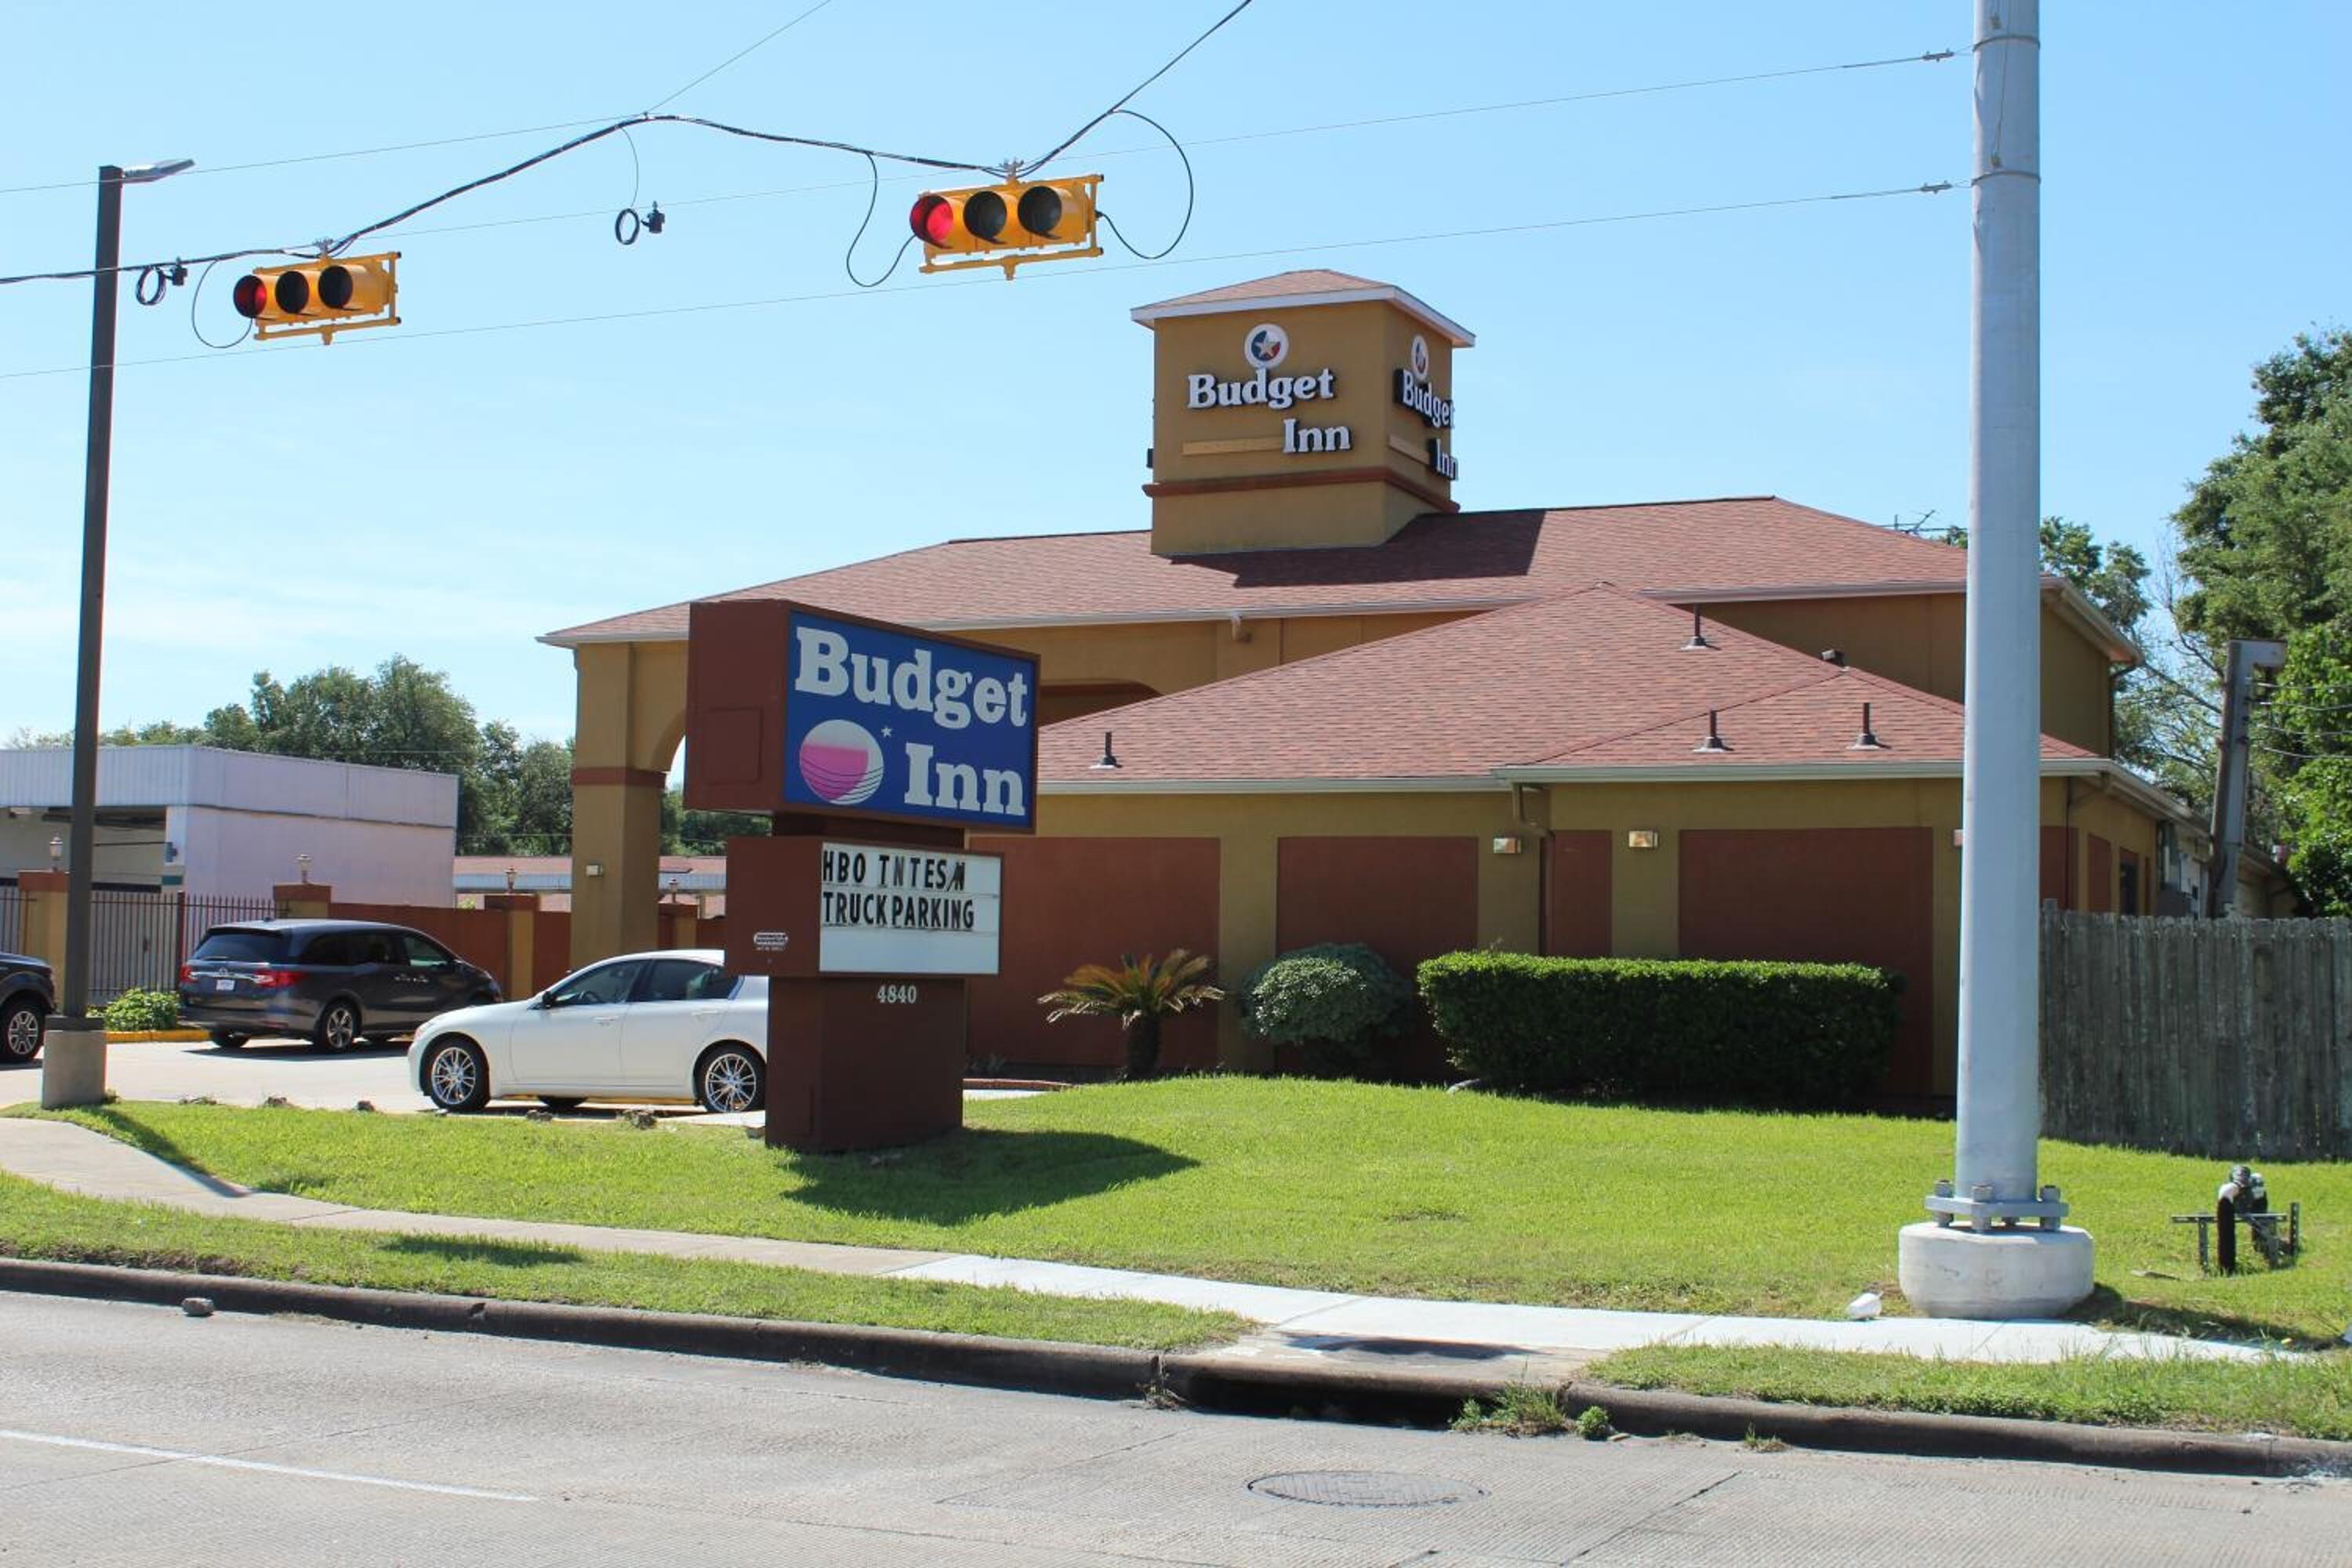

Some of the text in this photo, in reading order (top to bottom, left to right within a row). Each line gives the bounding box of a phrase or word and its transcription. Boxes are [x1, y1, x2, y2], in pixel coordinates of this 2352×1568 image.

[1188, 368, 1334, 410] Budget
[1283, 418, 1352, 454] Inn
[794, 626, 1027, 729] Budget
[903, 742, 1025, 817] Inn
[822, 850, 866, 884] HBO
[823, 891, 975, 929] TRUCK PARKING
[877, 985, 917, 1004] 4840
